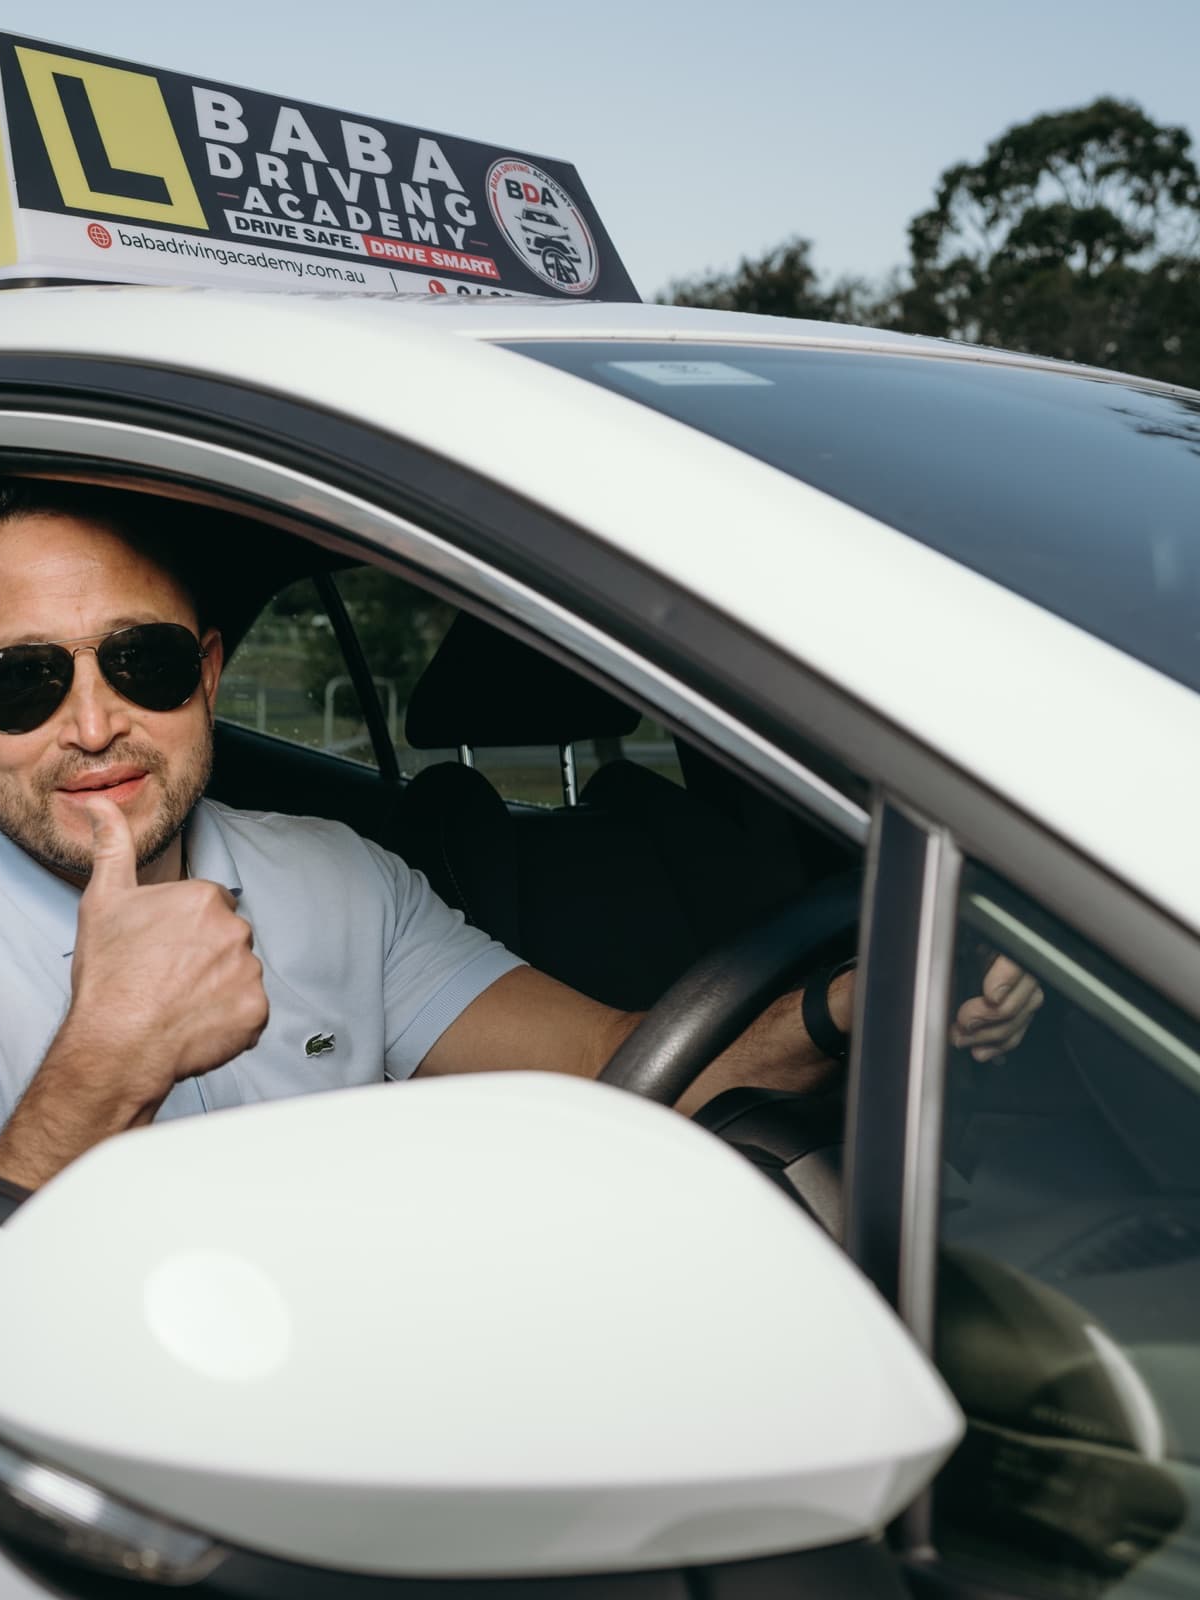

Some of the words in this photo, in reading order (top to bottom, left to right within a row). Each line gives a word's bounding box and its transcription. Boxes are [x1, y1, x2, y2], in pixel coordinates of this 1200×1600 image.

[52, 72, 173, 206] L
[192, 86, 465, 193] BABA
[205, 142, 477, 227] DRIVING
[504, 178, 559, 209] BDA
[235, 216, 298, 240] DRIVE
[303, 227, 360, 250] SAFE.
[369, 239, 428, 264] DRIVE
[432, 250, 497, 276] SMART.
[243, 187, 466, 250] ACADEMY
[117, 229, 366, 285] babadrivingacademy.com.au
